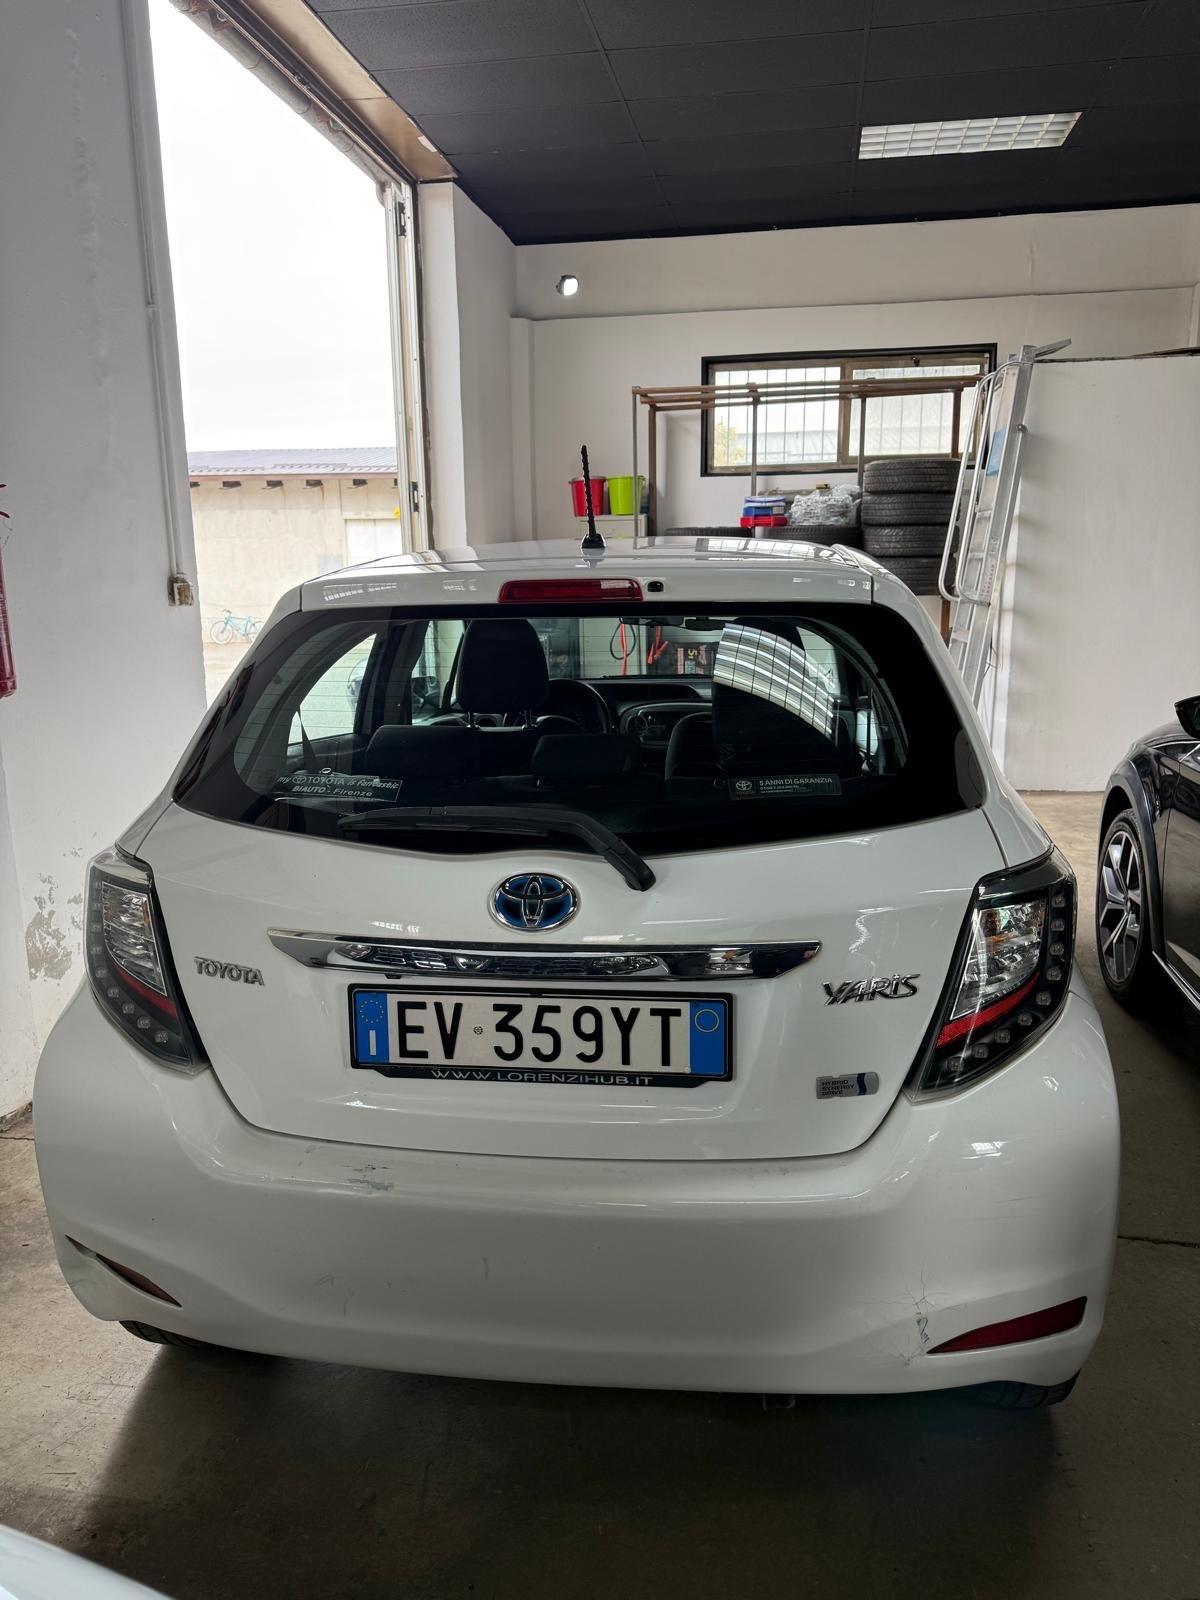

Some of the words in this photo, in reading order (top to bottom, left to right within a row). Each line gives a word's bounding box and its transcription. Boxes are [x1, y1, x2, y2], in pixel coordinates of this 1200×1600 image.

[308, 776, 345, 785] TOYOTA
[794, 777, 833, 785] GARANZIA
[292, 785, 326, 793] BIAUTO
[333, 788, 373, 797] Firenze
[194, 955, 265, 986] TOYOTA
[397, 1001, 463, 1060] EV
[492, 1003, 682, 1067] 359YT
[430, 1068, 654, 1087] WWW.LORENZIHUB.IT
[821, 1079, 849, 1087] HYBRID
[821, 1084, 855, 1092] SYNERGY
